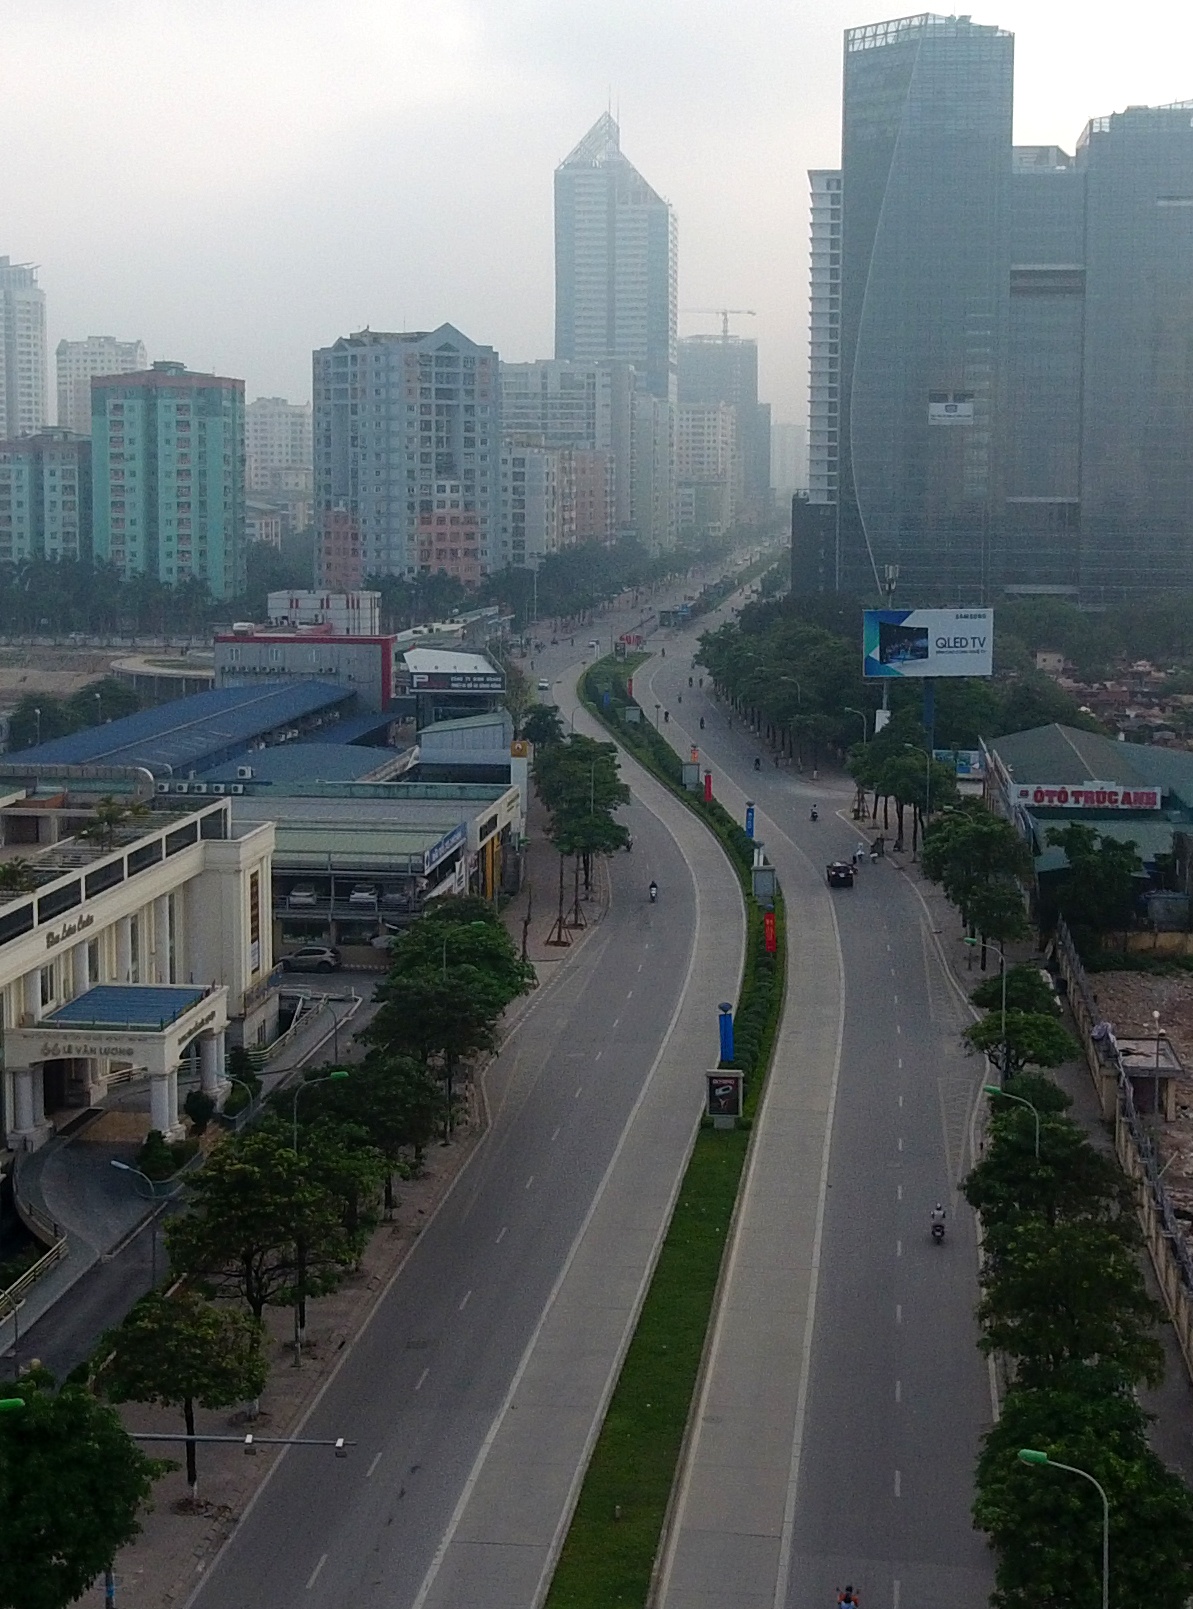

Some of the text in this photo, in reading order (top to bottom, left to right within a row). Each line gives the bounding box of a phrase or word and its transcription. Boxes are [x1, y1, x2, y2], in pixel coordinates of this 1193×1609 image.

[935, 636, 986, 649] QLED TV
[1071, 786, 1119, 805] TRÚC
[1120, 790, 1157, 806] ANH
